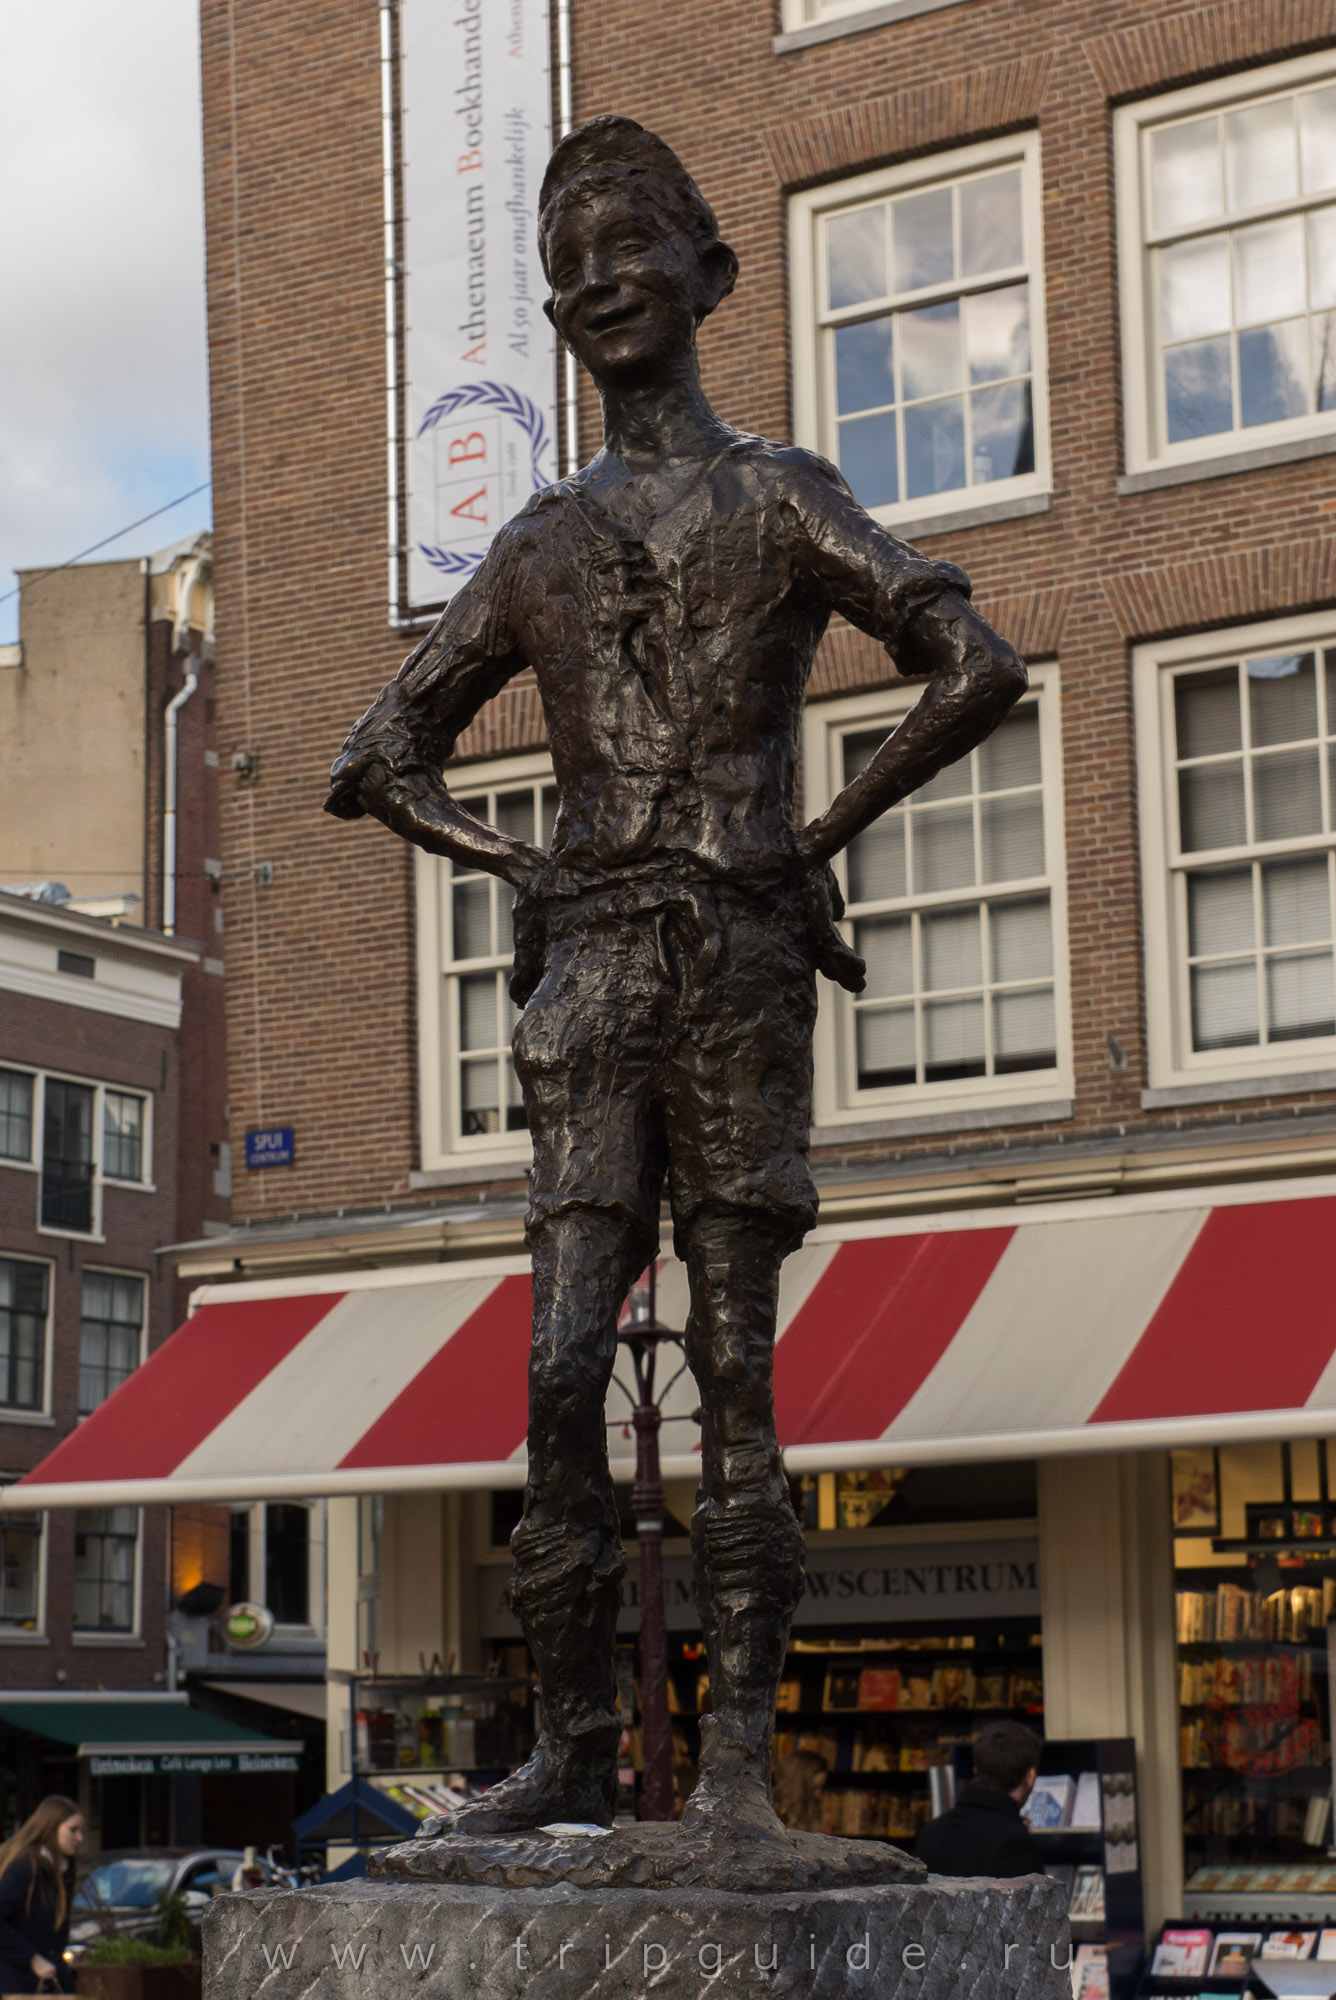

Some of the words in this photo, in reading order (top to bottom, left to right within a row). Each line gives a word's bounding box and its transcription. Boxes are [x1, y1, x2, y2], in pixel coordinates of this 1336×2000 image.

[454, 0, 483, 174] Boekhande
[503, 107, 533, 254] onafhankelijk
[458, 184, 486, 365] Athenaeum
[508, 258, 533, 305] jaar
[506, 331, 530, 357] Al
[254, 1131, 283, 1151] SPUI
[804, 1561, 1039, 1600] WSCENTRUM
